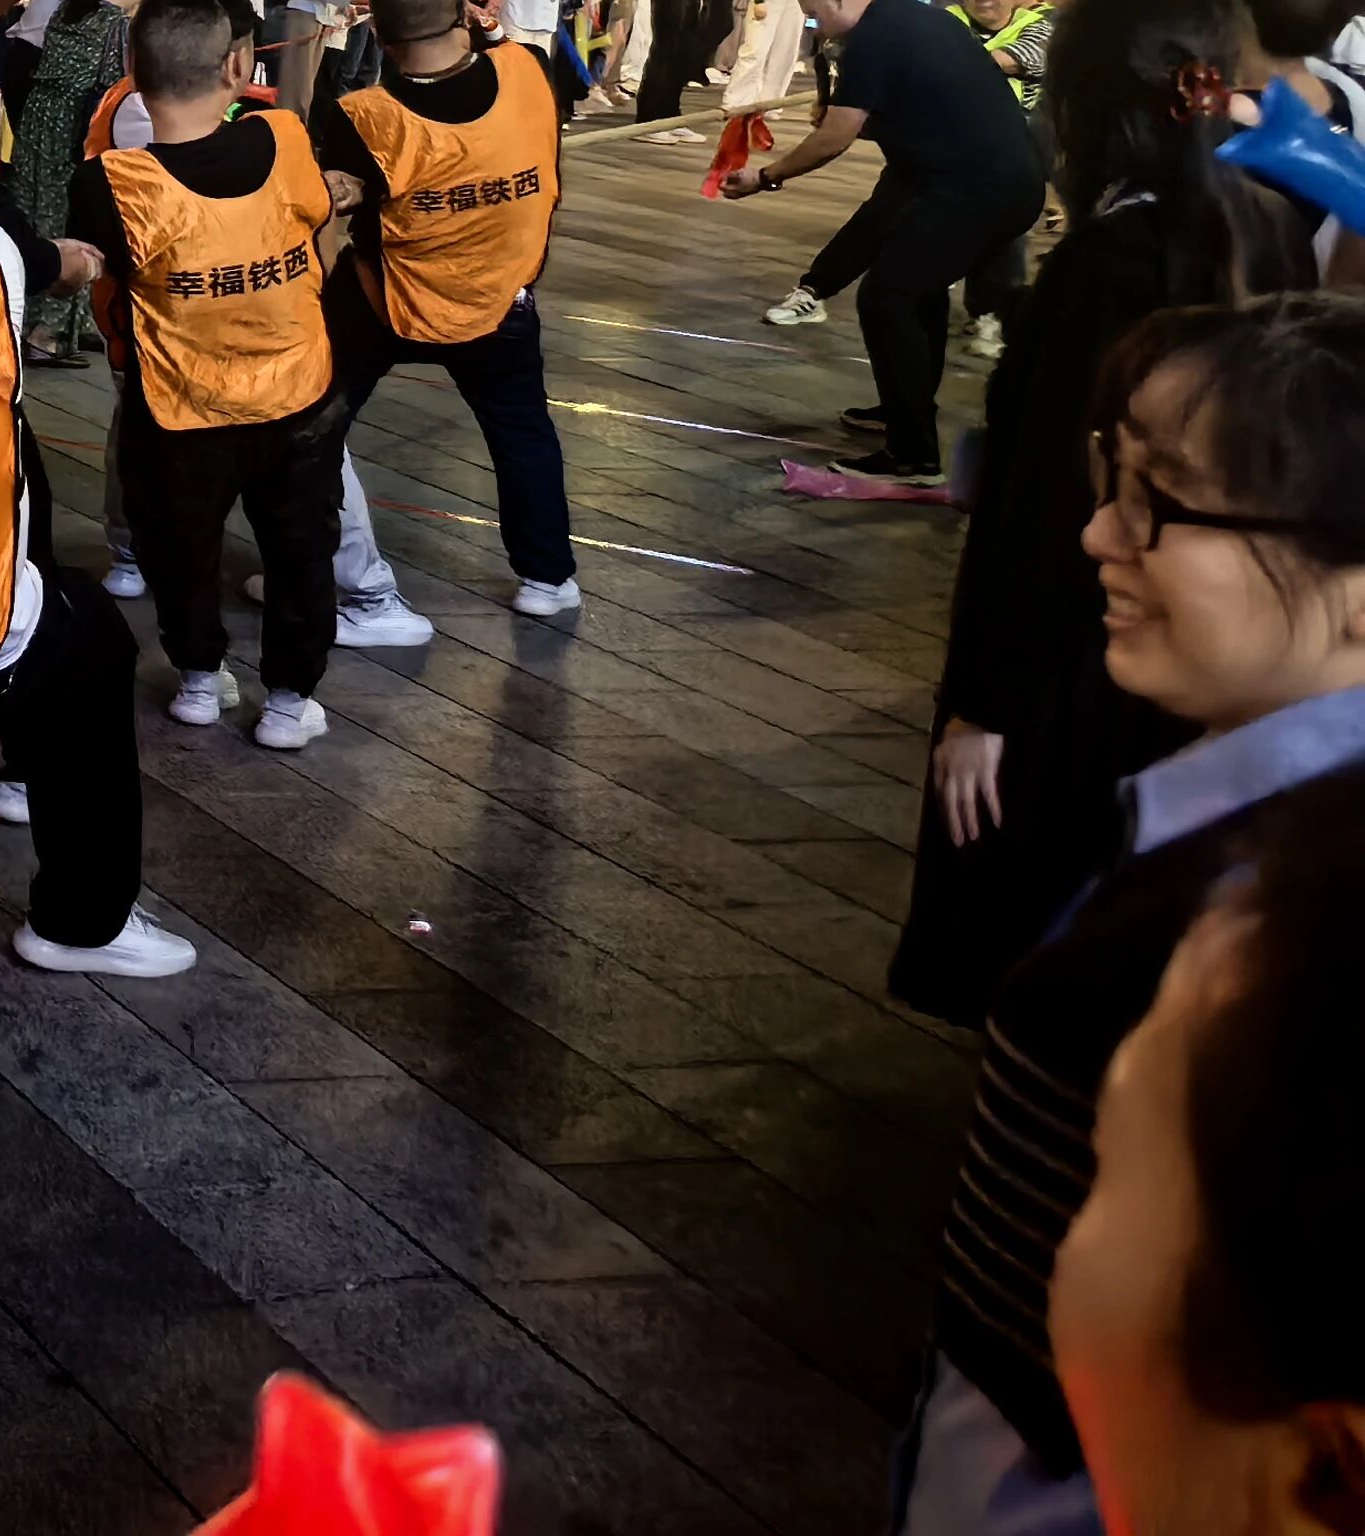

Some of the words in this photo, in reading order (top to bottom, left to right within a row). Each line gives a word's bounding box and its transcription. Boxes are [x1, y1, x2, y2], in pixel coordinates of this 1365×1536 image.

[411, 166, 540, 214] 幸福铁西
[166, 240, 309, 299] 幸福铁西
